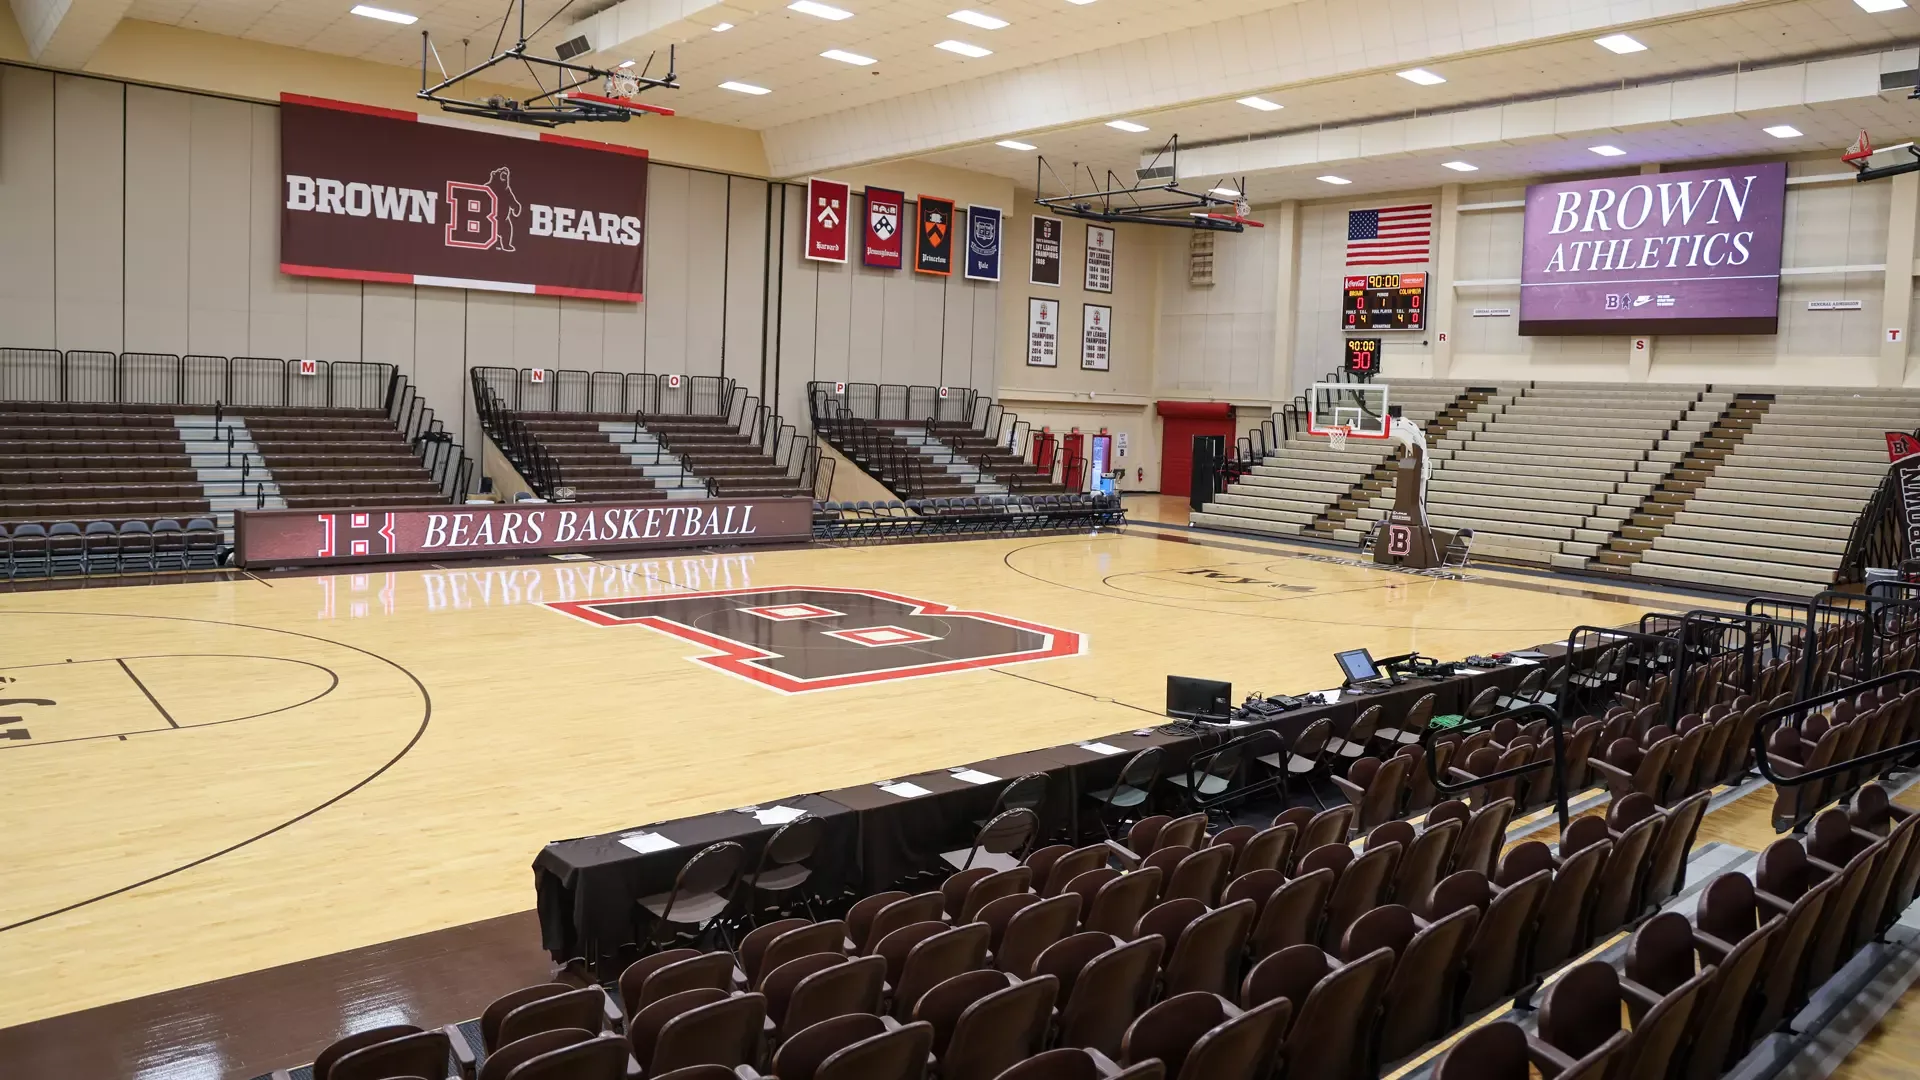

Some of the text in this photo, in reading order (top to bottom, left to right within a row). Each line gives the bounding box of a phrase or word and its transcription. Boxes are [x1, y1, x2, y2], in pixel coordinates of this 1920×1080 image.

[1548, 175, 1757, 235] BROWN
[286, 174, 642, 250] BROWN B BEARS
[816, 240, 840, 251] Harvard
[1043, 244, 1058, 253] LEAGUE
[866, 246, 899, 258] Pennsylvania
[1035, 250, 1058, 259] CHAMPIONS
[1543, 231, 1754, 273] ATHLETICS
[922, 253, 947, 264] Princeton
[1088, 259, 1110, 267] CHAMPIONS
[978, 261, 989, 270] Yale
[1369, 275, 1399, 288] 90:00
[1357, 297, 1364, 309] 0
[1412, 295, 1420, 308] 0
[1349, 314, 1355, 324] 0
[1360, 314, 1367, 323] 4
[1397, 314, 1404, 323] 4
[1412, 313, 1418, 323] 0
[1032, 332, 1054, 340] CHAMPIONS
[1093, 331, 1107, 339] LEAGUE
[1439, 333, 1446, 341] R
[1889, 330, 1900, 340] T
[1086, 337, 1107, 345] CHAMPIONS
[1348, 341, 1375, 351] 90:00
[1636, 340, 1644, 350] S
[1352, 352, 1371, 369] 30
[302, 361, 315, 373] M
[533, 370, 543, 381] N
[670, 376, 679, 386] O
[837, 384, 844, 392] P
[941, 388, 948, 397] Q
[421, 511, 545, 549] BEARS
[554, 505, 757, 543] BASKETBALL
[1388, 524, 1411, 556] B
